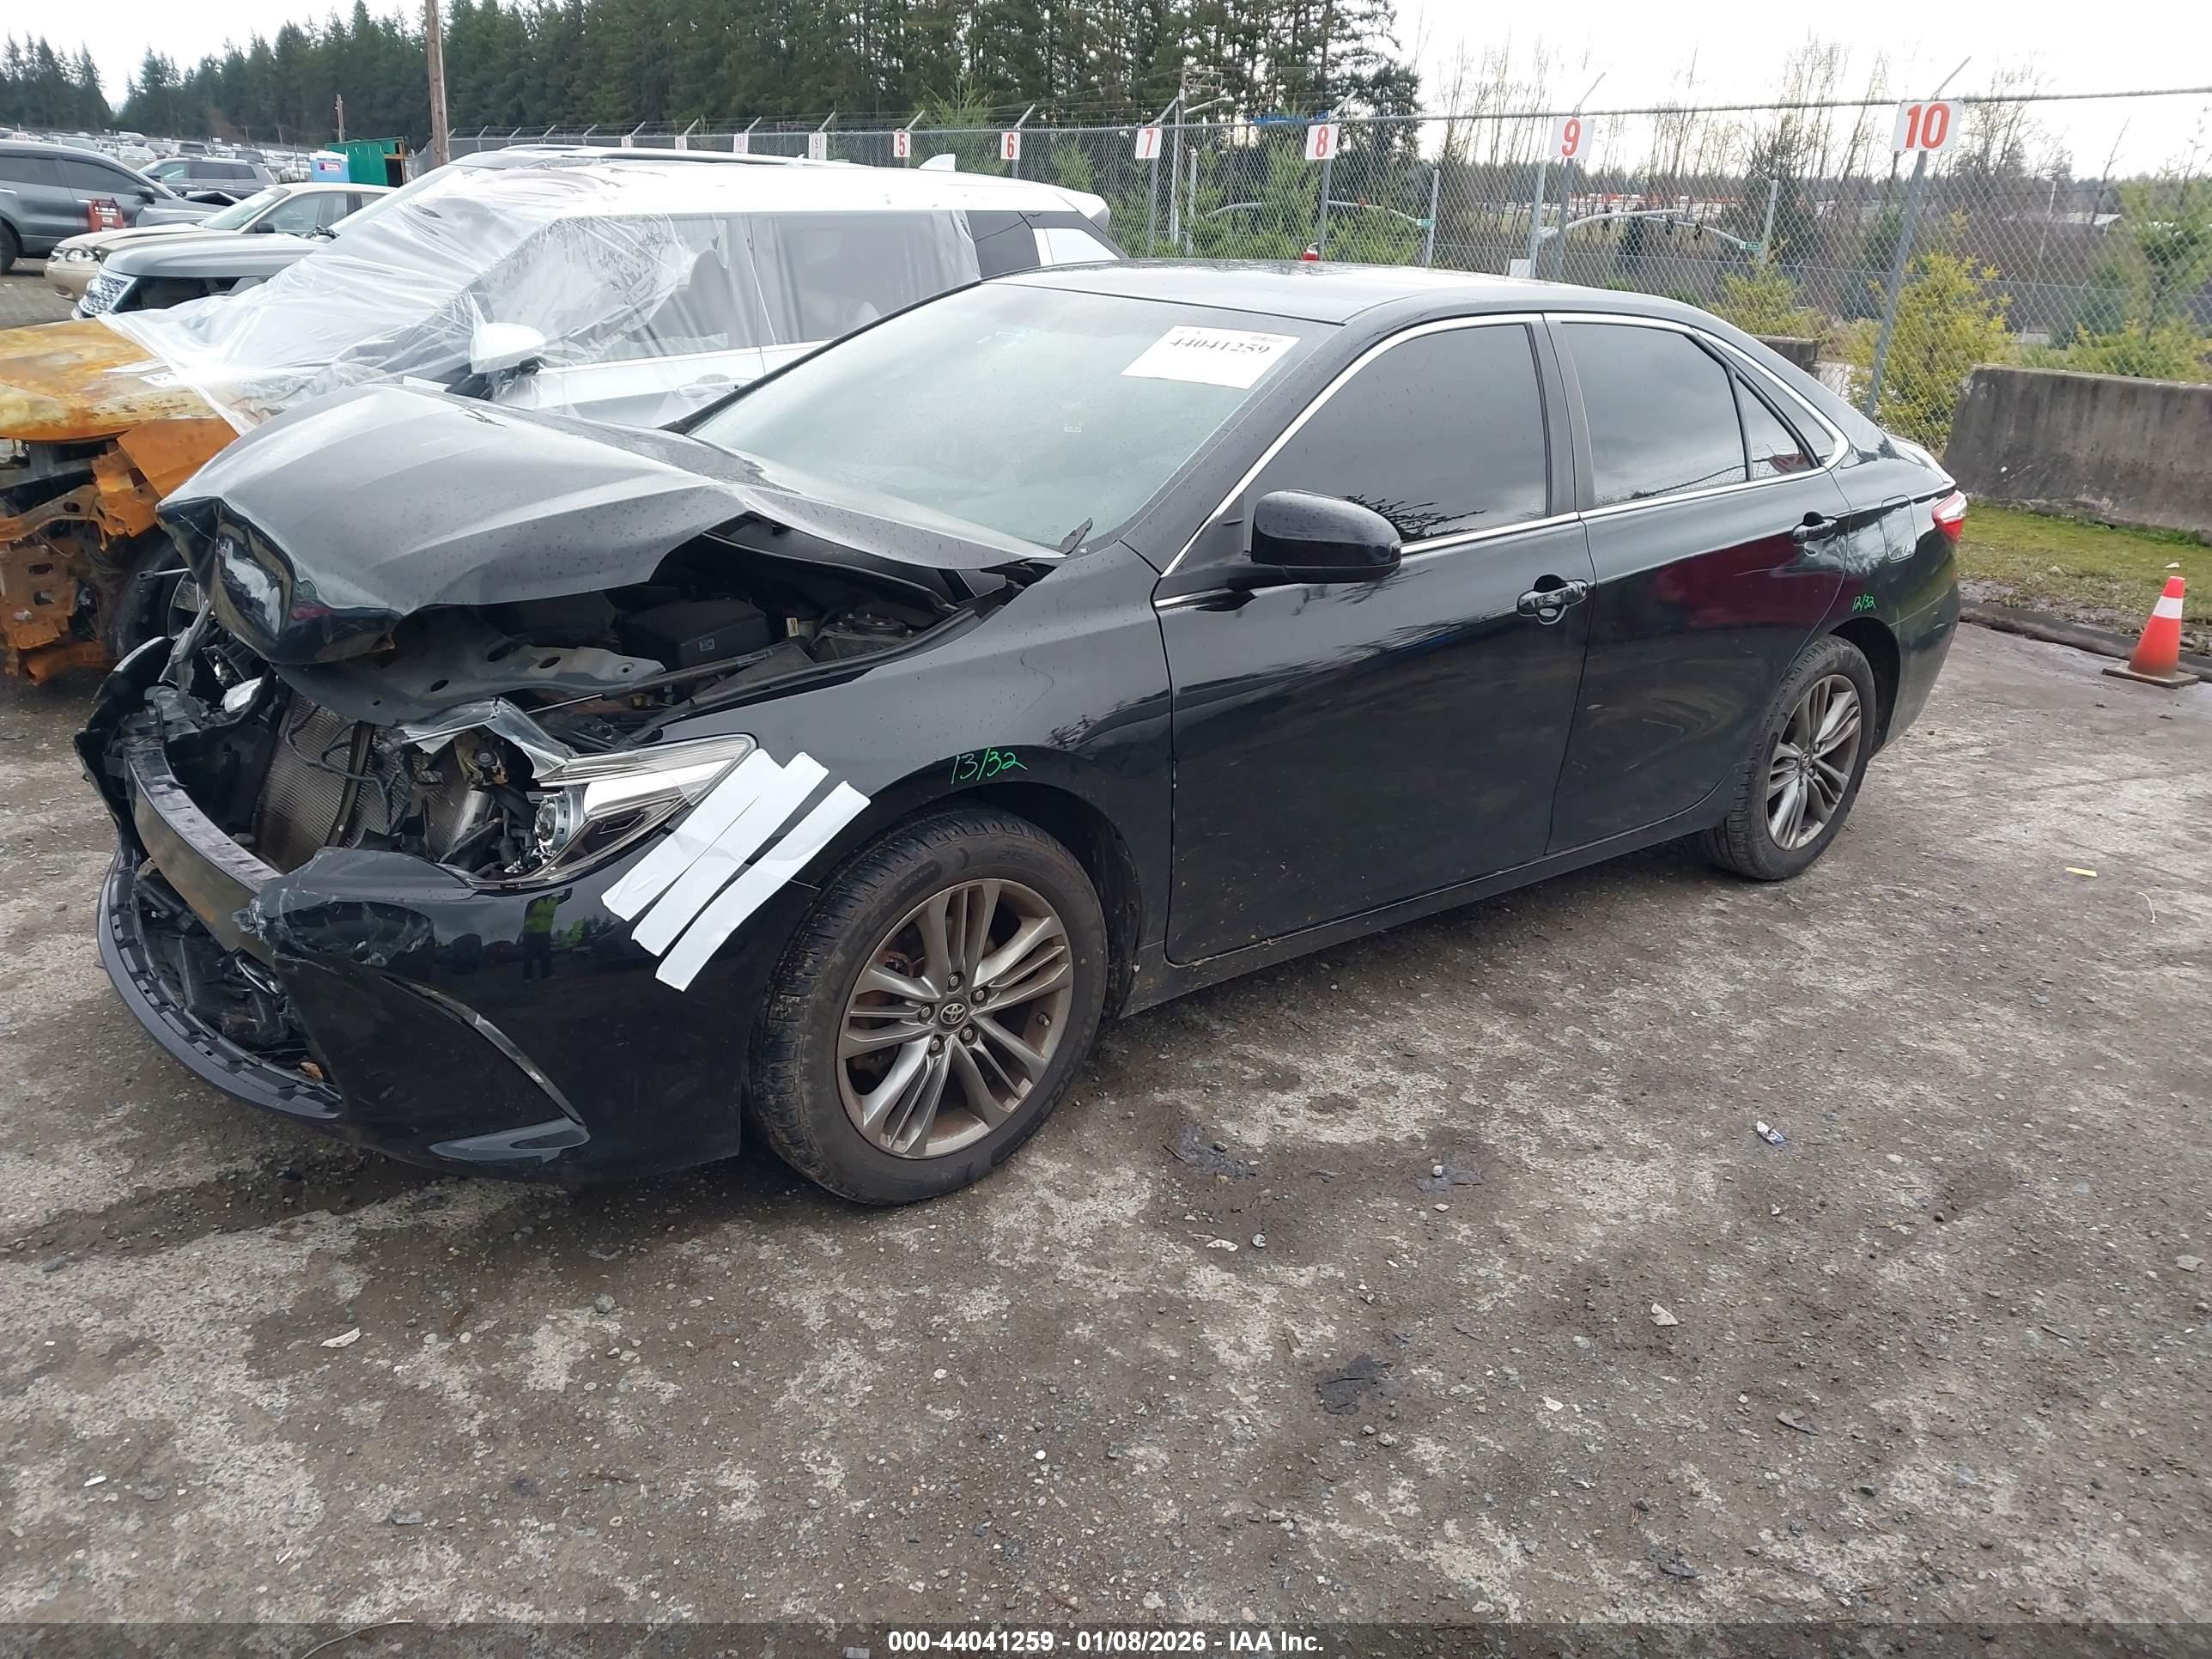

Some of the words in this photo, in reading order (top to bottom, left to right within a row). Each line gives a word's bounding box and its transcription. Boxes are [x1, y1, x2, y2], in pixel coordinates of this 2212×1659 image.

[1562, 118, 1581, 156] 9
[1905, 102, 1951, 149] 10
[898, 133, 906, 156] 5
[1006, 133, 1015, 159] 6
[1145, 129, 1155, 157] 7
[1316, 125, 1329, 158] 8
[1851, 593, 1877, 612] 12/32
[950, 747, 1029, 785] 13/32
